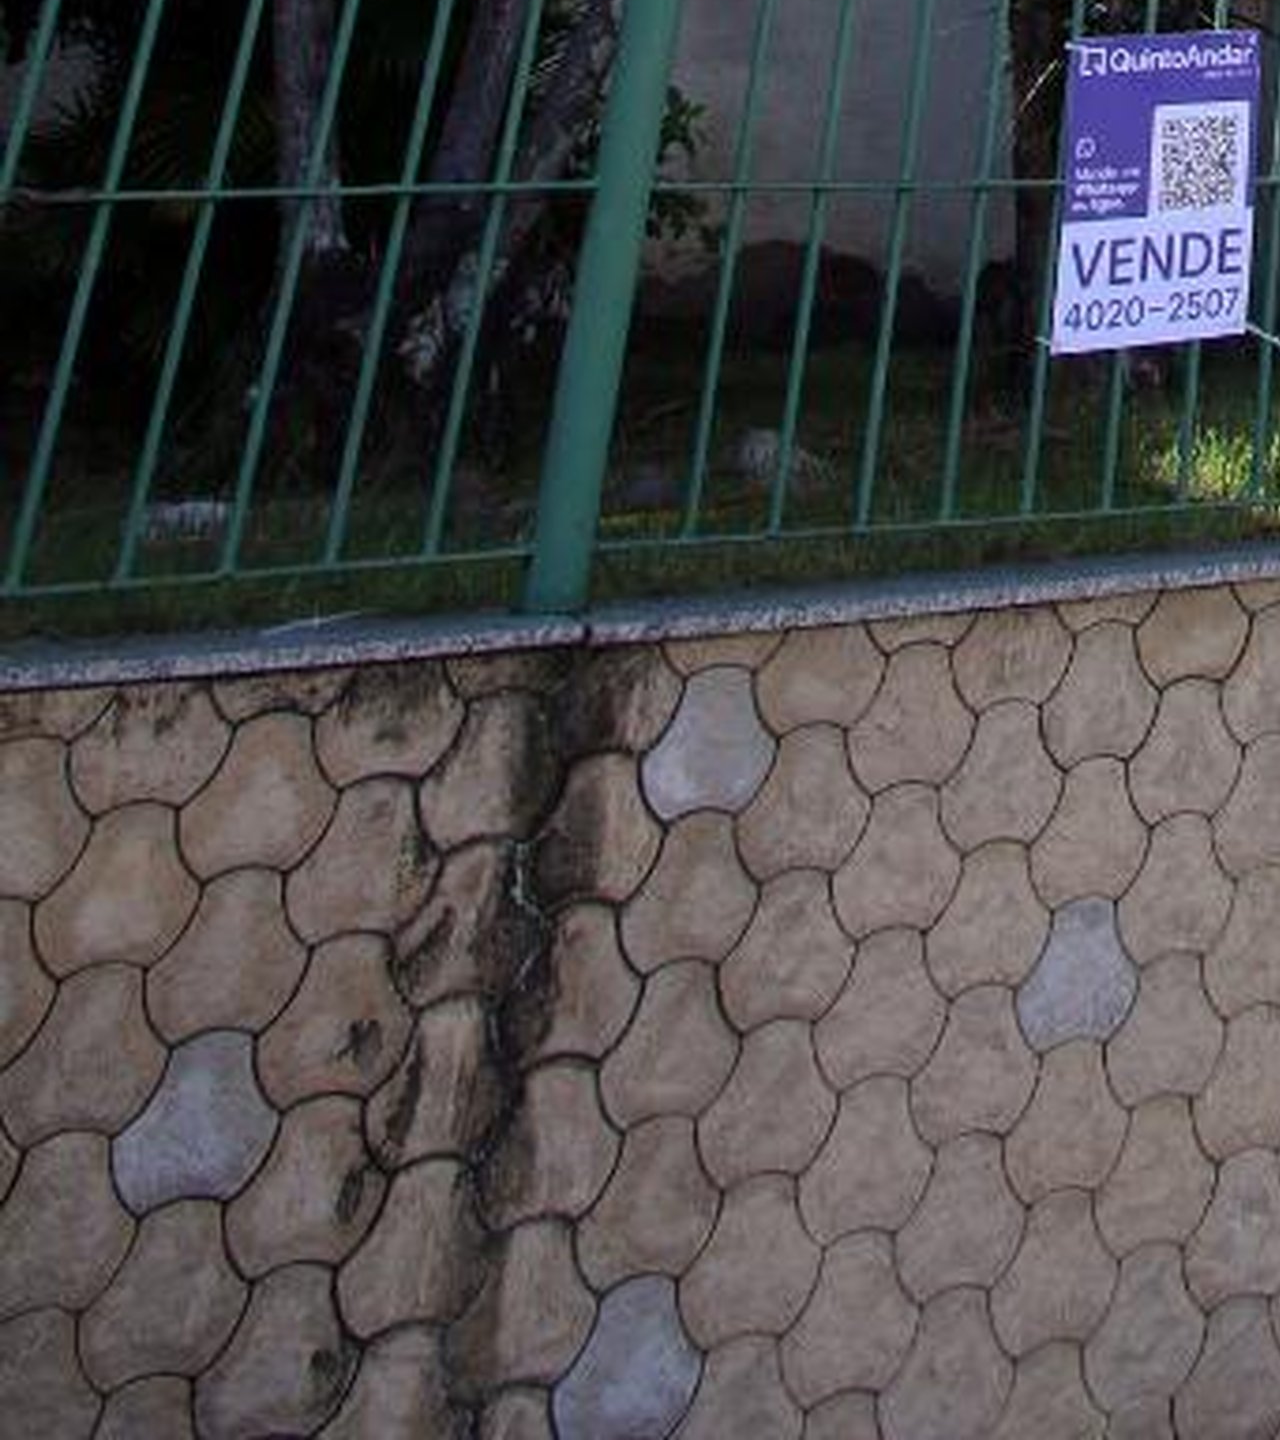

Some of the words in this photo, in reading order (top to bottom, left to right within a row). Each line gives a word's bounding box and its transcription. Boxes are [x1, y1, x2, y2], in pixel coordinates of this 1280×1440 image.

[1109, 43, 1254, 74] QuintoAndar
[1072, 229, 1243, 288] VENDE
[1064, 288, 1239, 332] 4020-2507
